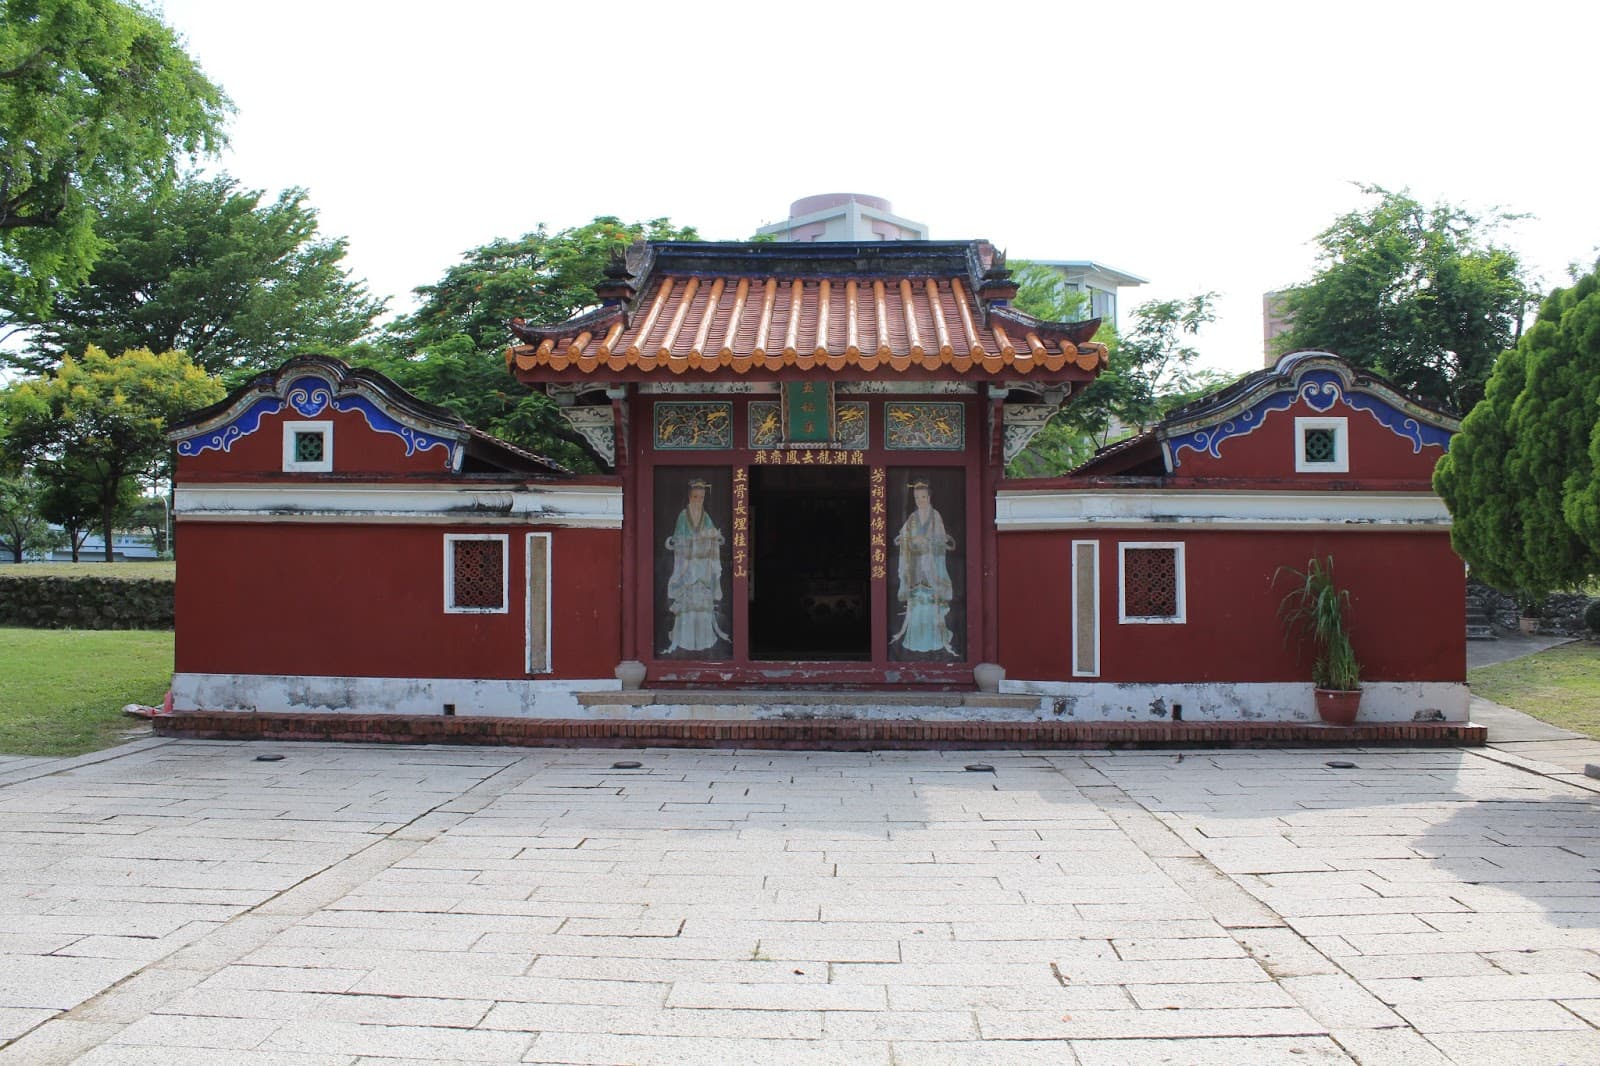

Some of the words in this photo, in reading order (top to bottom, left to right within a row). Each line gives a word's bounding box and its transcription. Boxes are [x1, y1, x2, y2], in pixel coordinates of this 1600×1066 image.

[733, 468, 748, 577] 玉骨長埋桂子山
